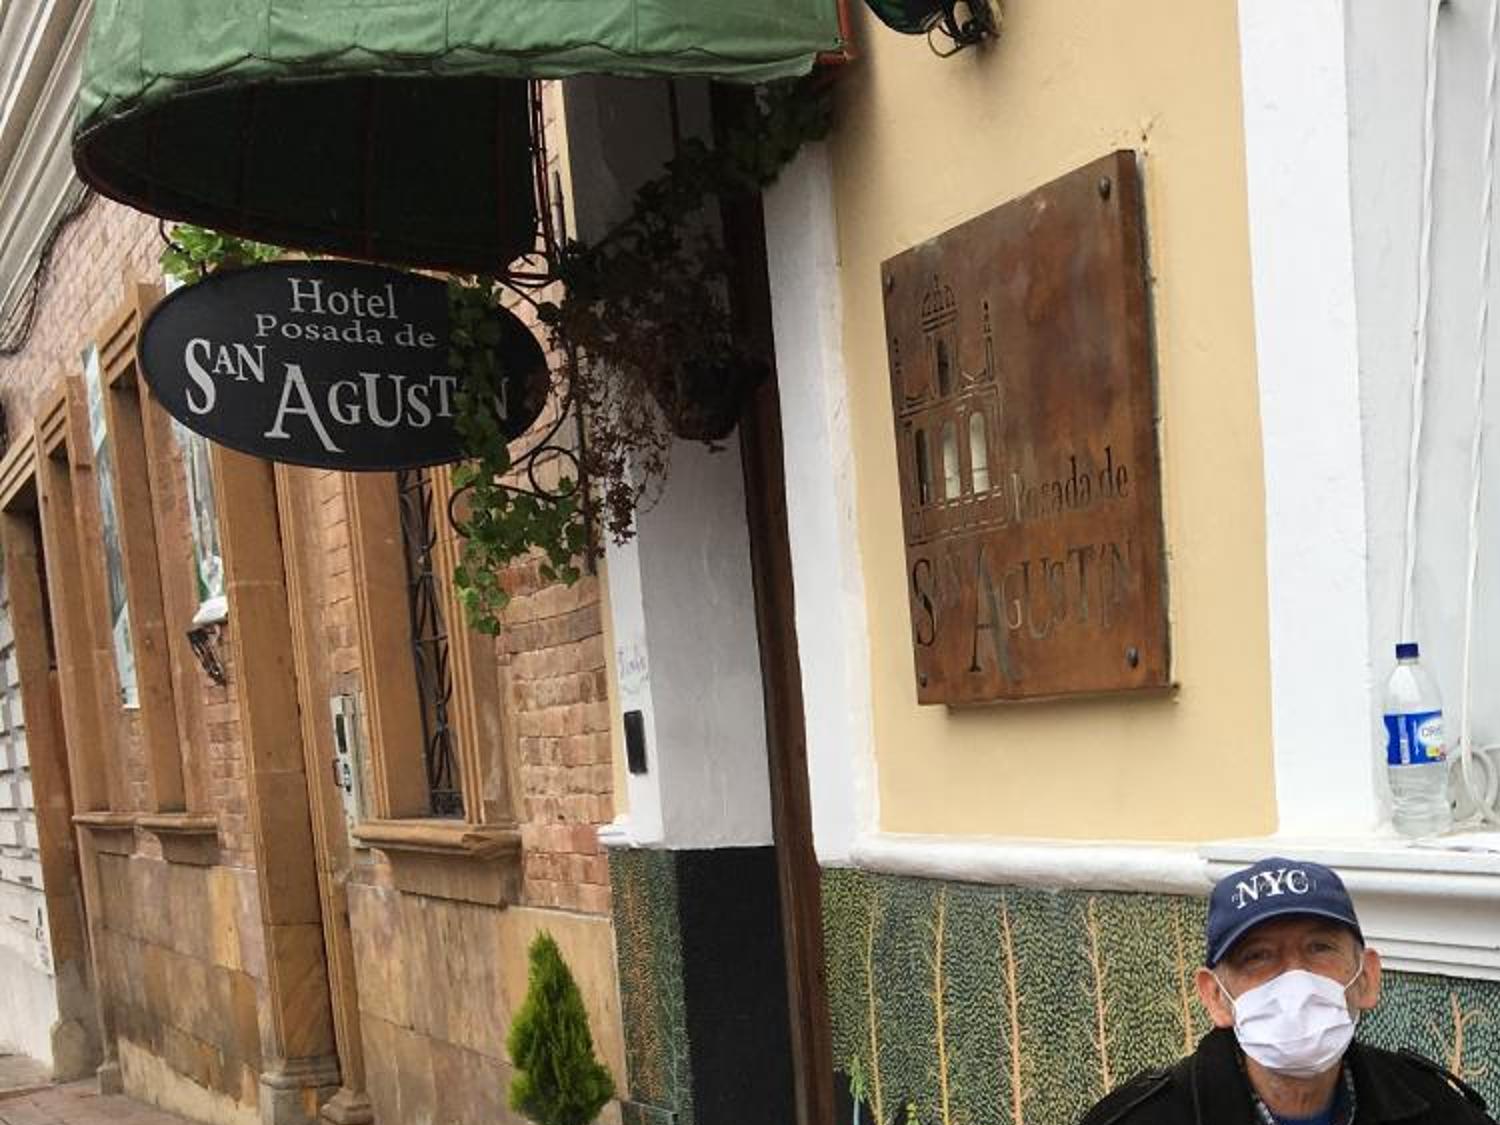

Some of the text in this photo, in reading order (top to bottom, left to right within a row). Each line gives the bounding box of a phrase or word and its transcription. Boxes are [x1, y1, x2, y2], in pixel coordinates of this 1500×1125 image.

[288, 277, 399, 320] Hotel
[255, 313, 437, 350] Posada de
[184, 337, 510, 454] SAN AGUSTN
[1100, 446, 1129, 499] de
[1235, 867, 1310, 910] NYC
